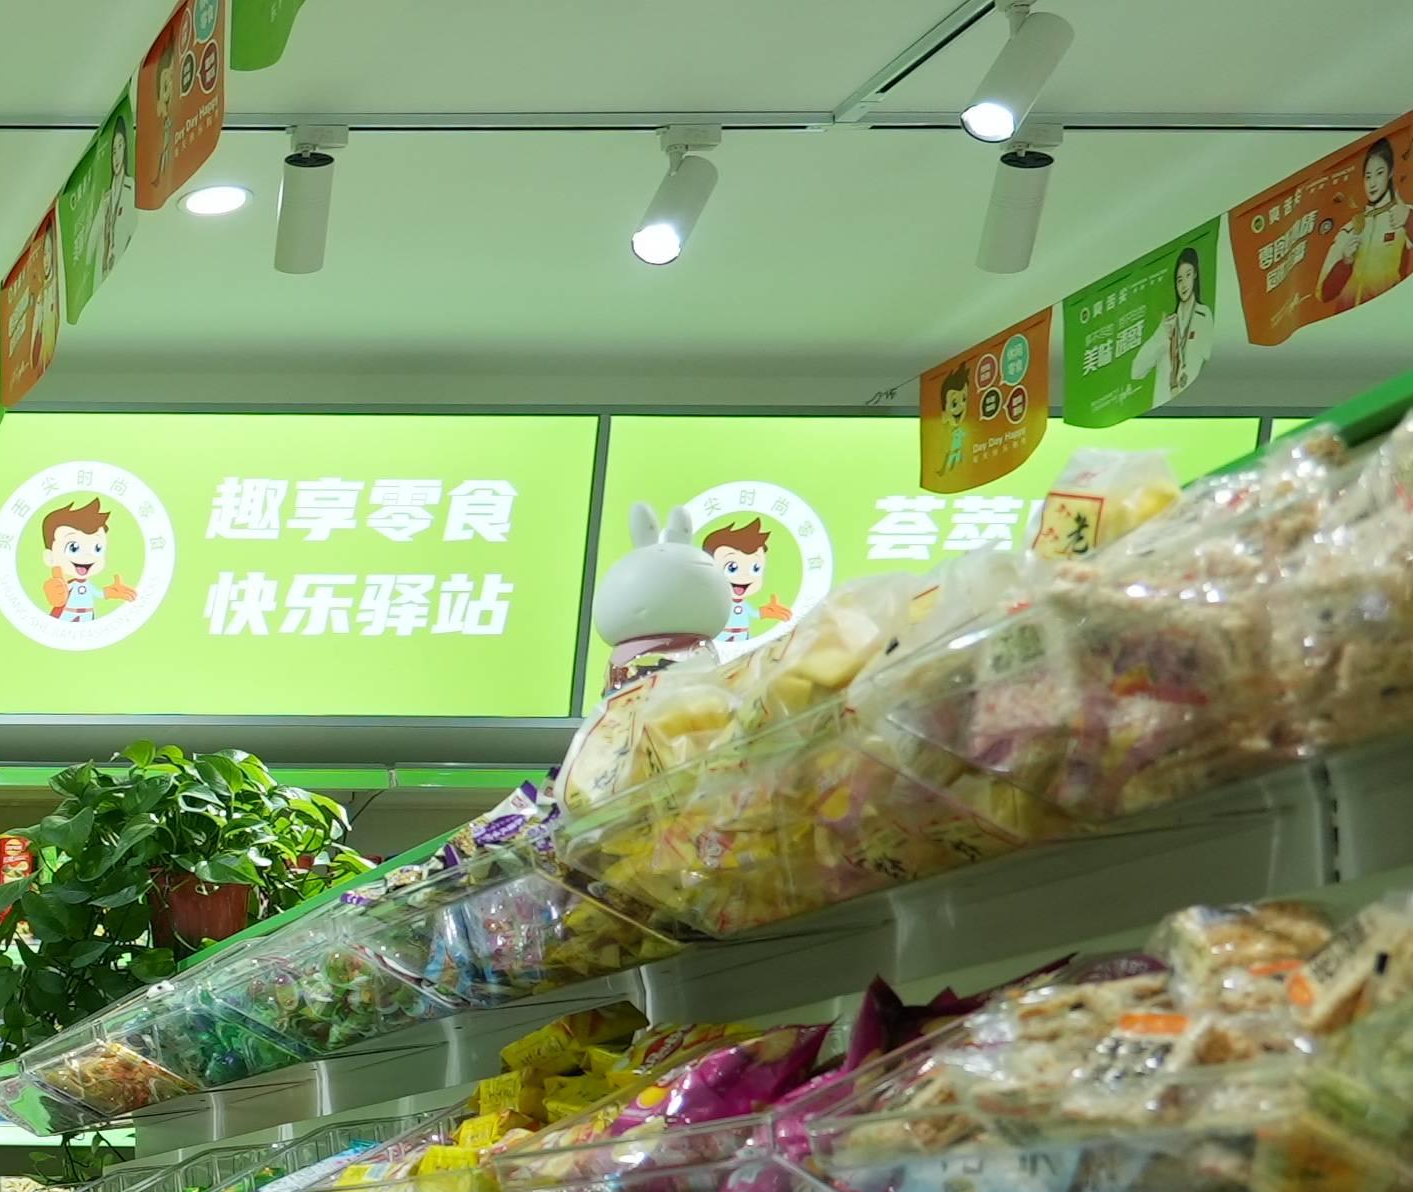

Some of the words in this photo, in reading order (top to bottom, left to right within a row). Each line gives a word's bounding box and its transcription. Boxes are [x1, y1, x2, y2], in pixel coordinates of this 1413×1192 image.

[208, 478, 516, 540] 趣享零食
[206, 573, 512, 635] 快乐驿站
